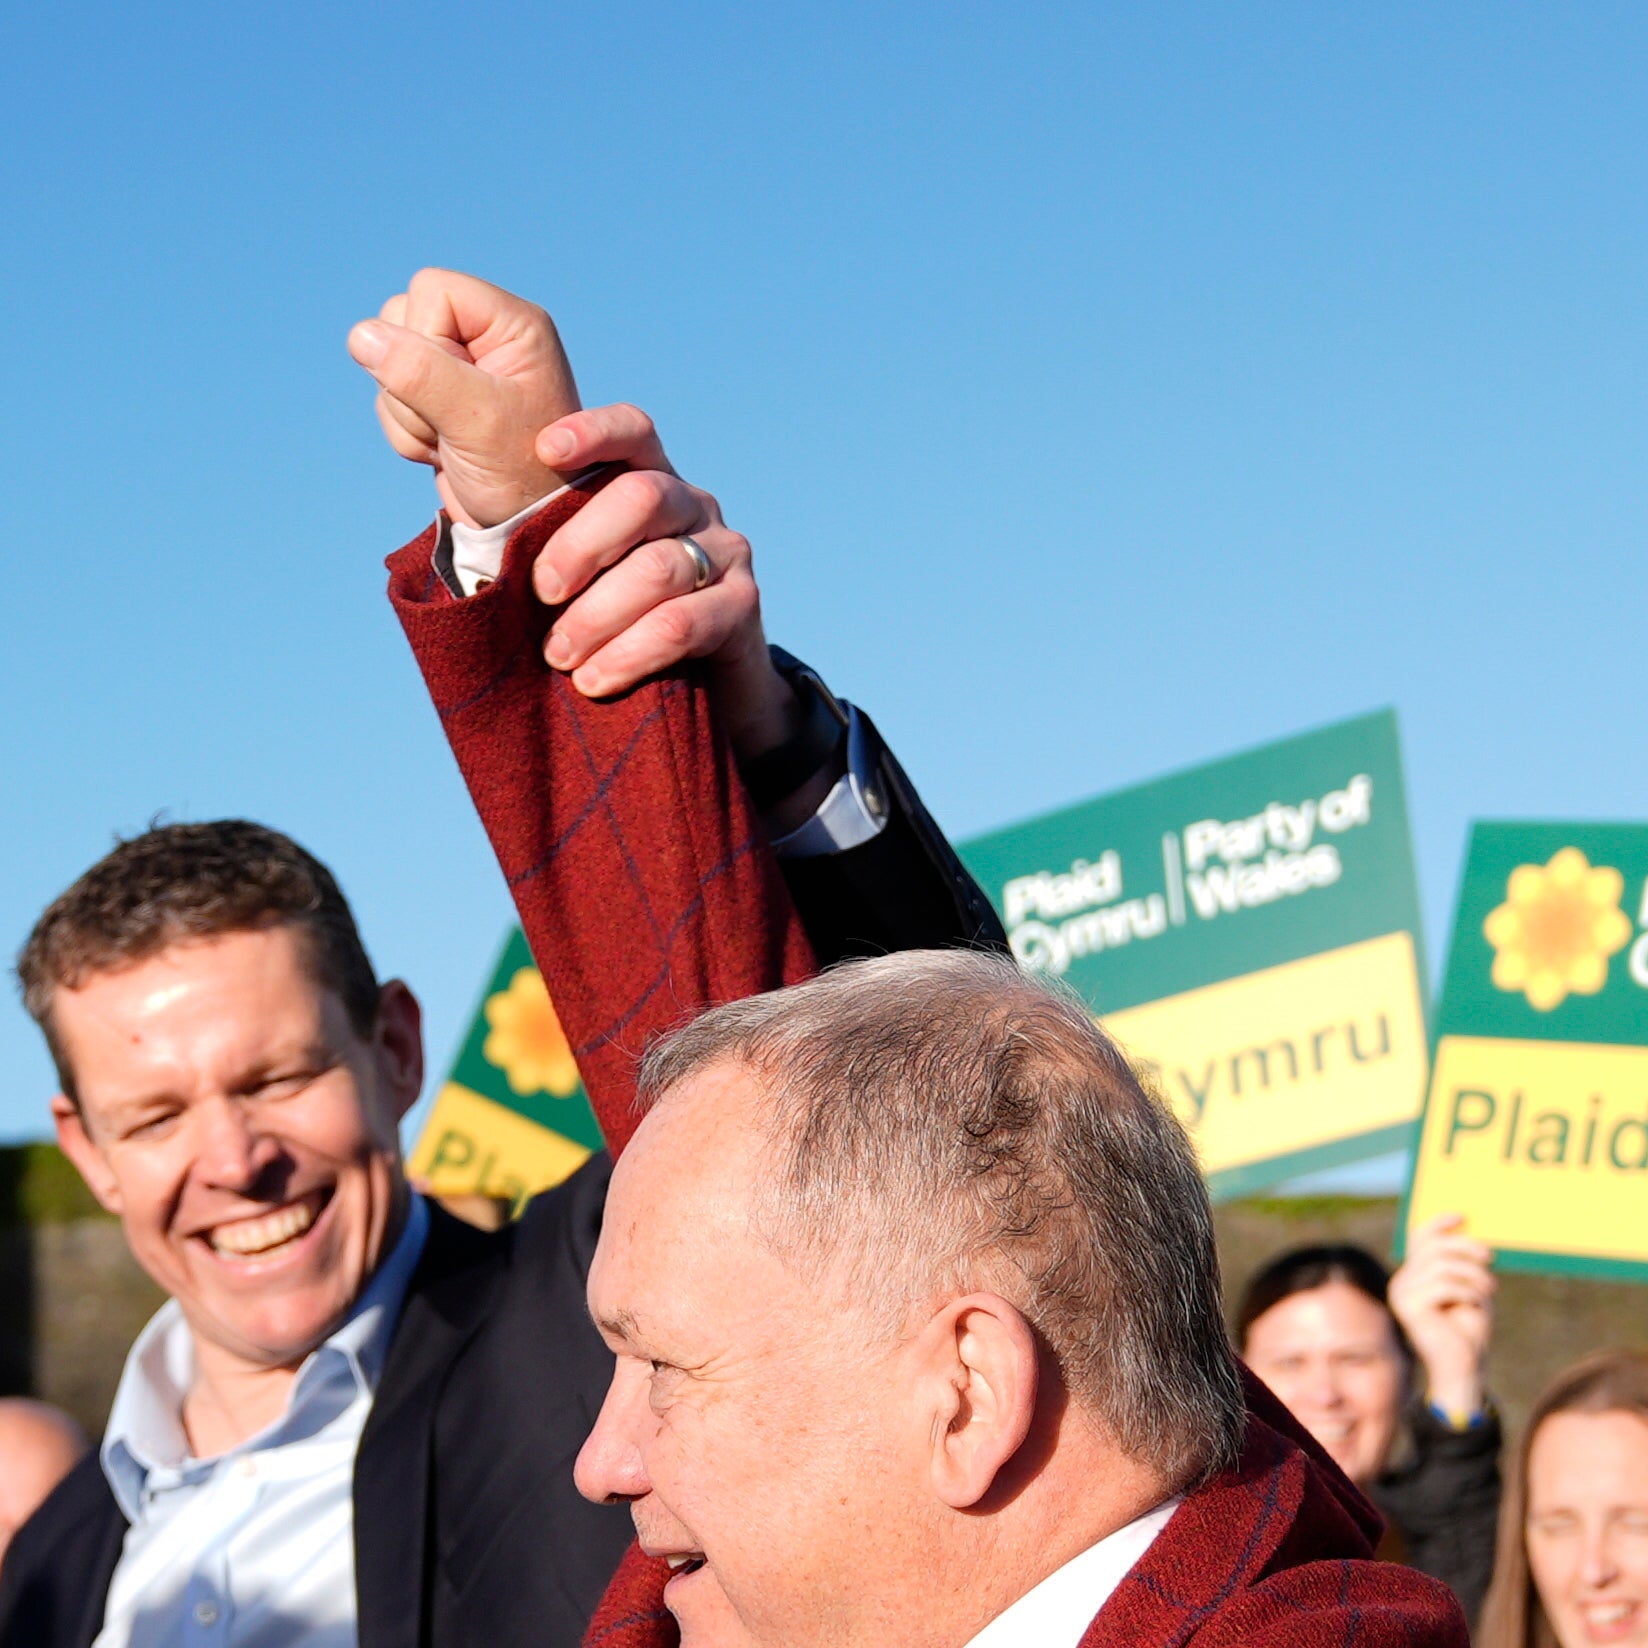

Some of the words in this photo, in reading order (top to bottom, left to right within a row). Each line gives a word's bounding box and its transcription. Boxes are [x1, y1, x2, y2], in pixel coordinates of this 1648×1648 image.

[1184, 798, 1318, 870] Party
[1318, 774, 1373, 832] of
[1002, 848, 1123, 928] Plaid
[1188, 843, 1342, 920] Wales
[1008, 892, 1168, 976] Cymru
[1147, 1008, 1392, 1125] ymru
